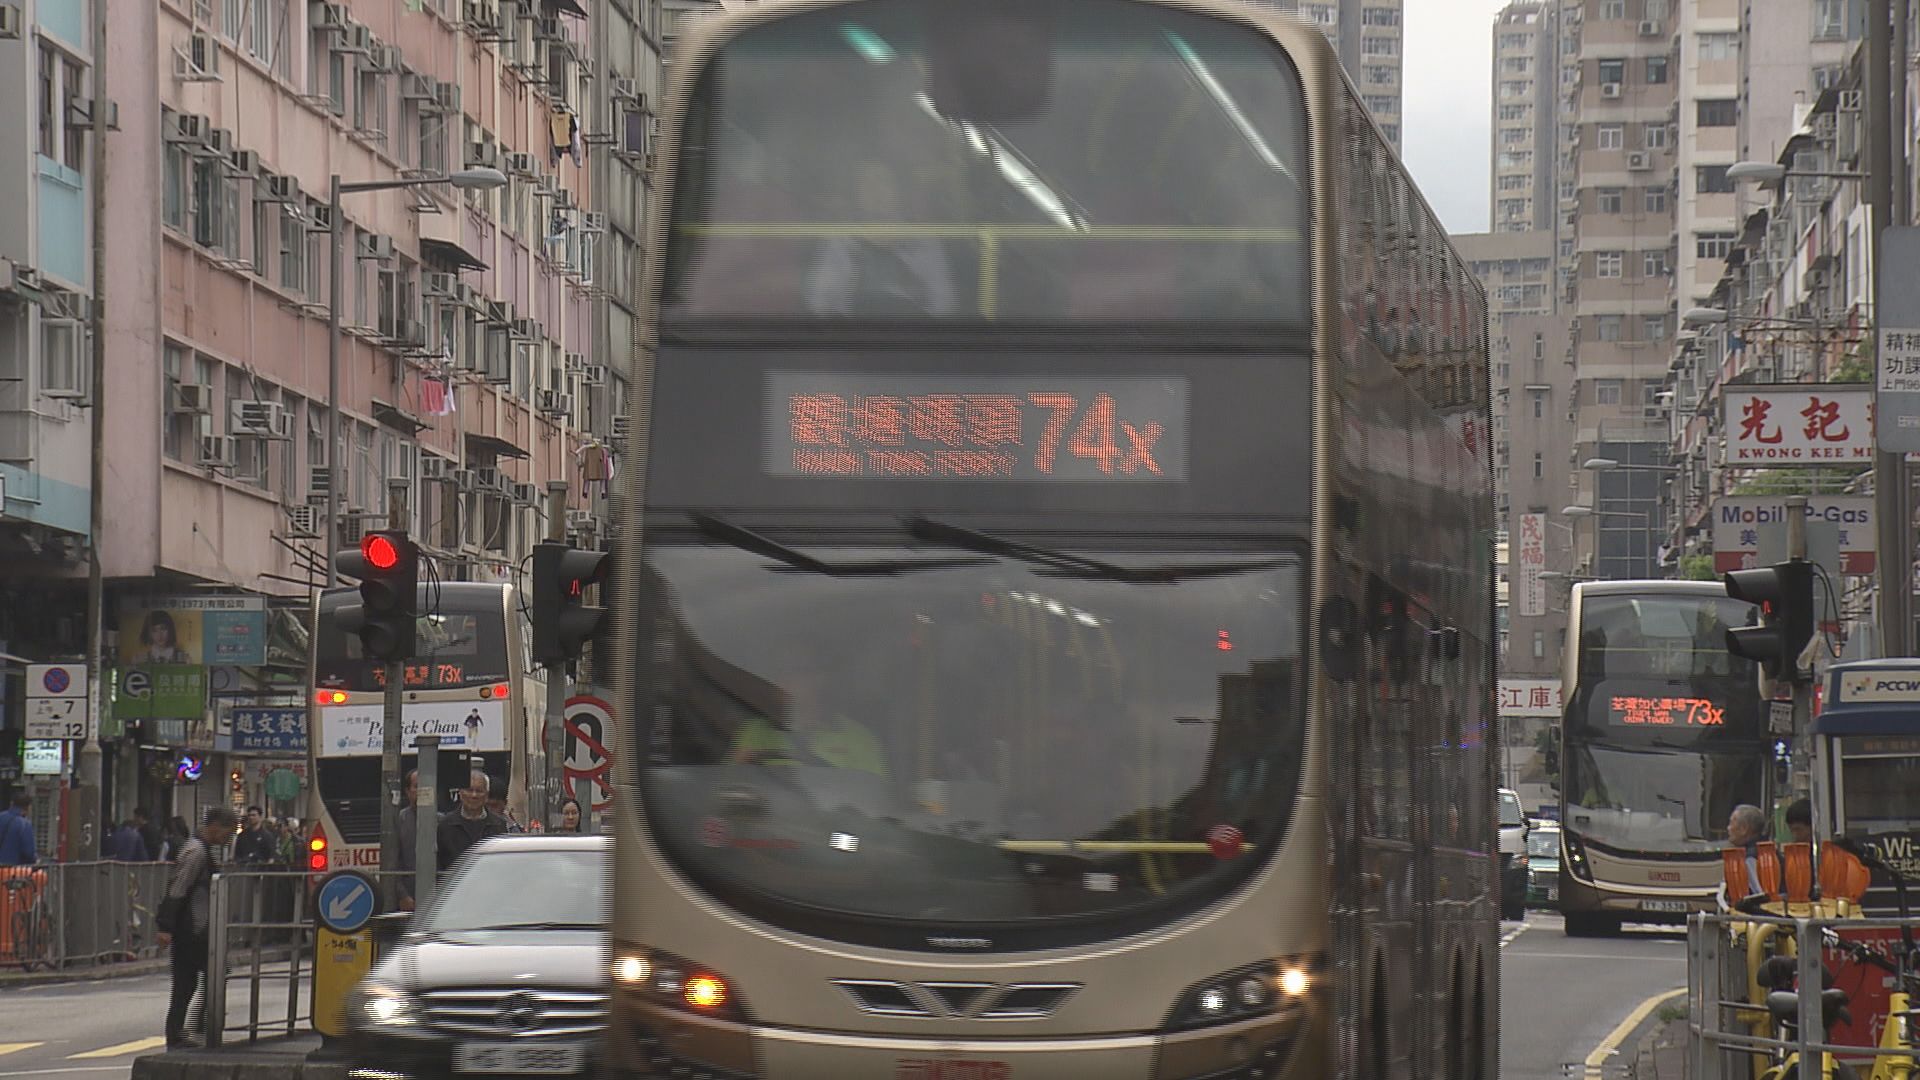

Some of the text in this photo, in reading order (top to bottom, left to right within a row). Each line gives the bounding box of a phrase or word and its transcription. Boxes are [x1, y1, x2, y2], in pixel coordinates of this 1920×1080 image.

[1739, 448, 1801, 458] KWONG
[1811, 448, 1843, 457] KEE
[1722, 506, 1868, 524] Mobil P-Gas
[1875, 681, 1920, 691] PCCW
[64, 700, 74, 714] 7
[423, 719, 459, 735] Chan
[353, 848, 381, 866] KM
